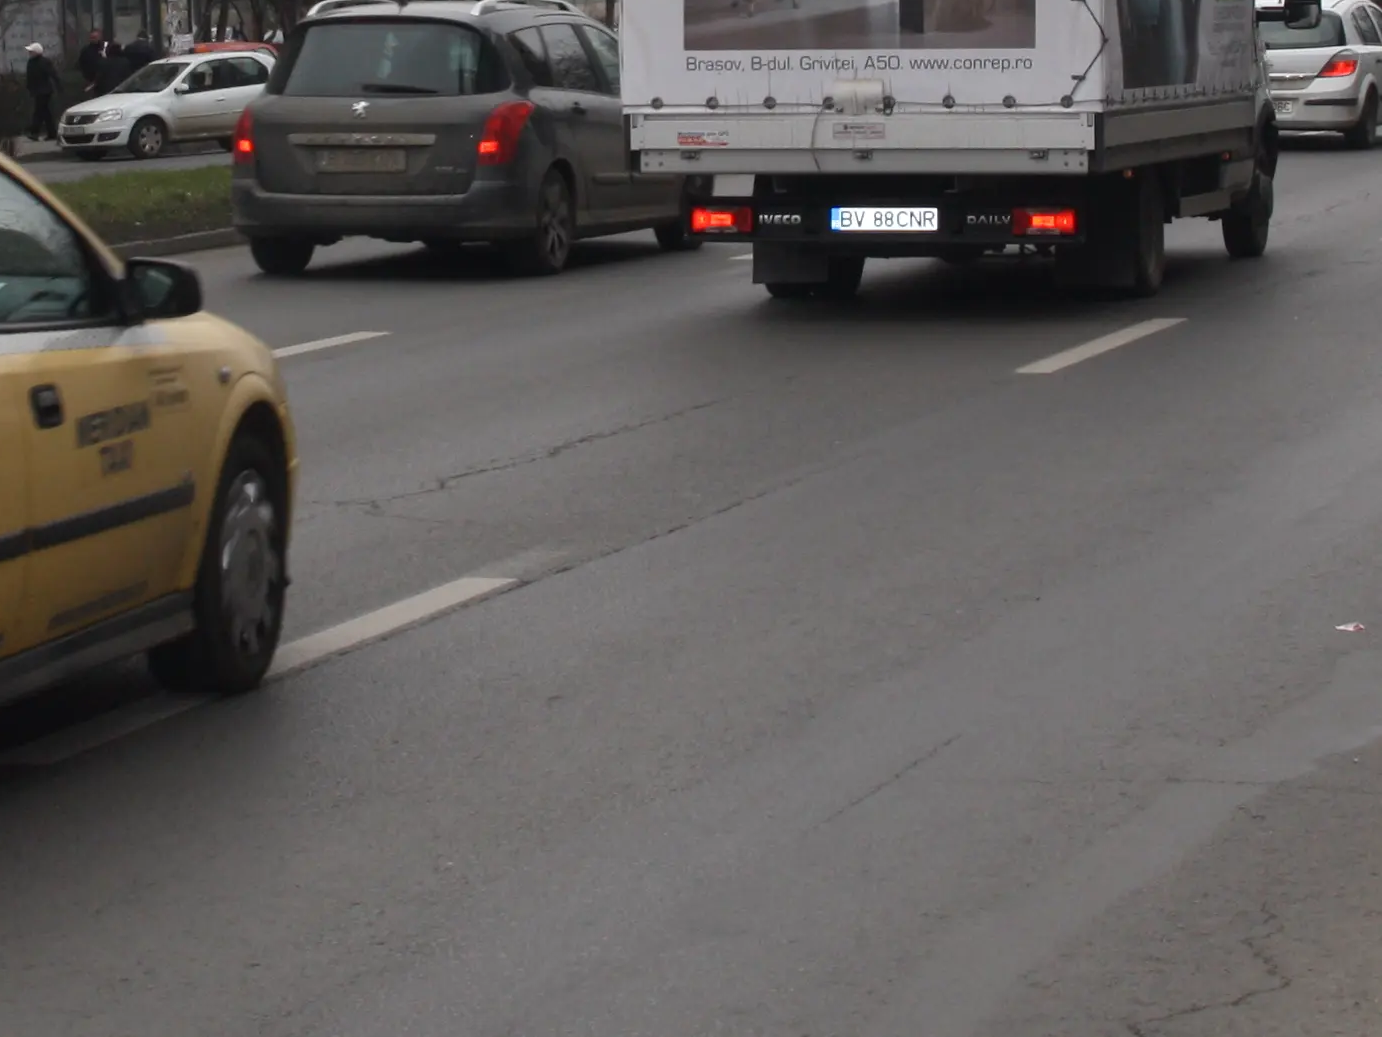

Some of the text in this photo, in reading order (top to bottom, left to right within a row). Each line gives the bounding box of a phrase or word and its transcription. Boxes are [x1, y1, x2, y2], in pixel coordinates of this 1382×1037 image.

[909, 56, 1033, 73] www.conrep.ro
[758, 213, 1011, 225] IVECO DAILY
[840, 210, 865, 228] BV
